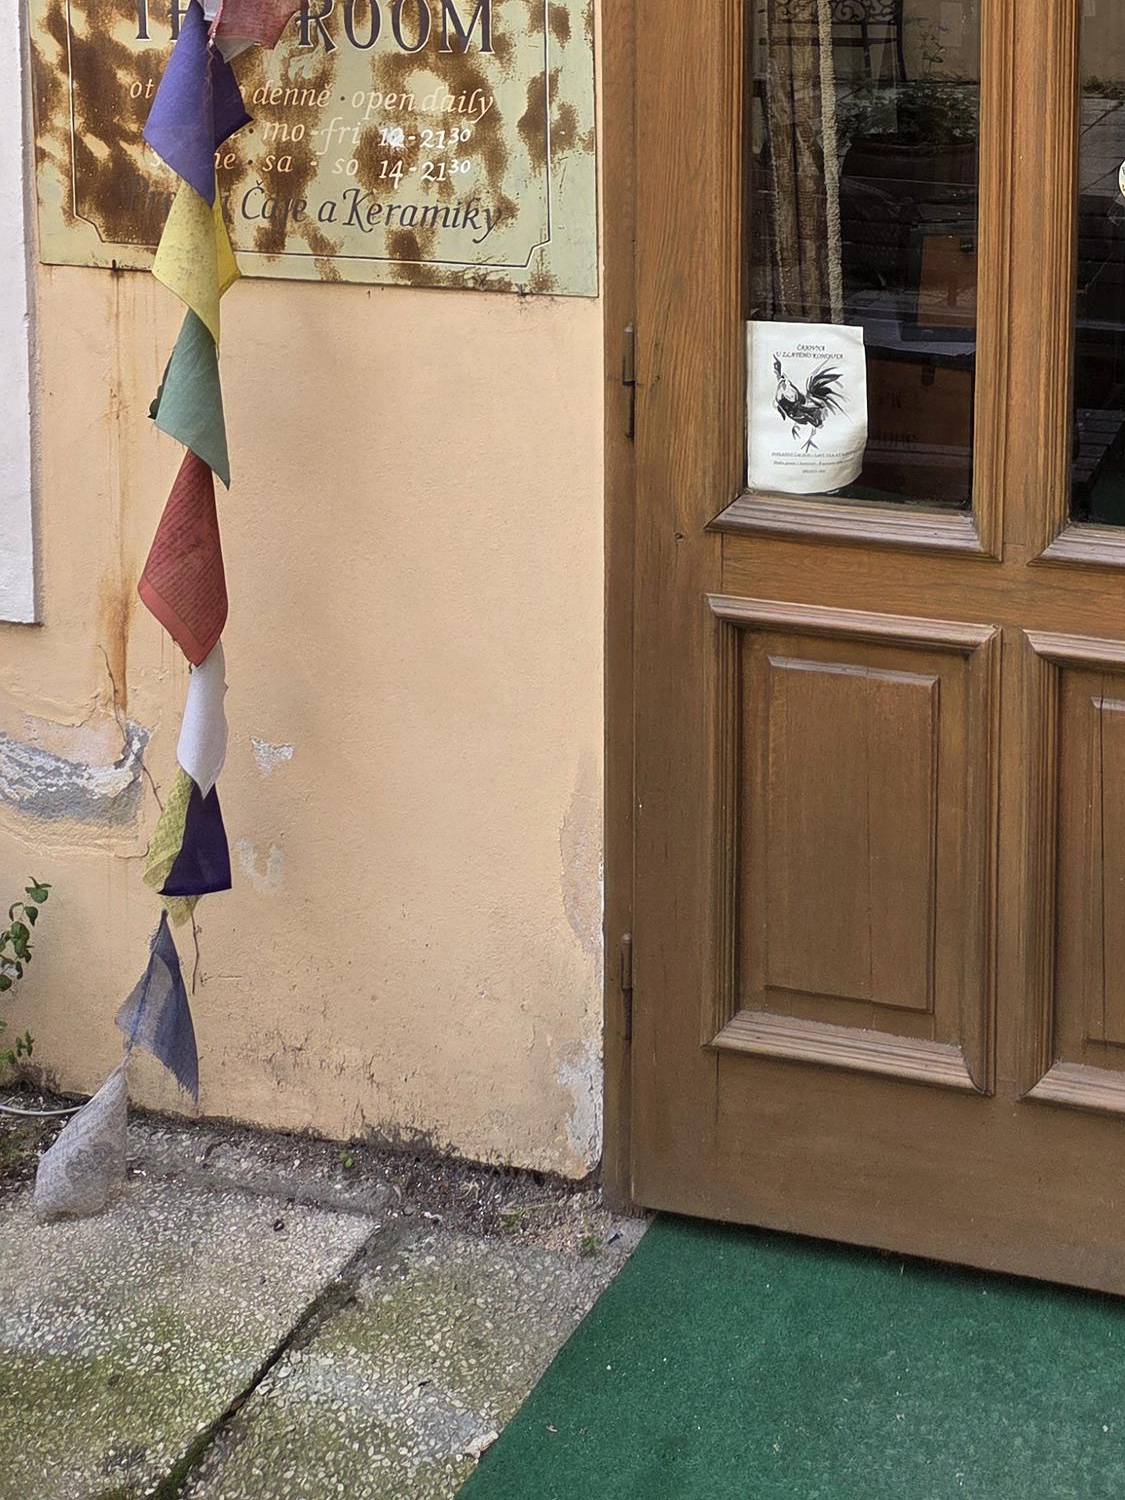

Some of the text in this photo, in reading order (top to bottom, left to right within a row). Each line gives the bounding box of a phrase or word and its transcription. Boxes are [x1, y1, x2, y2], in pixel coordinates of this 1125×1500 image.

[253, 80, 331, 108] denně
[351, 90, 416, 121] open
[422, 86, 494, 124] daily
[263, 152, 293, 173] sa
[332, 158, 358, 176] so
[318, 199, 337, 223] a
[343, 188, 500, 244] Keramiky
